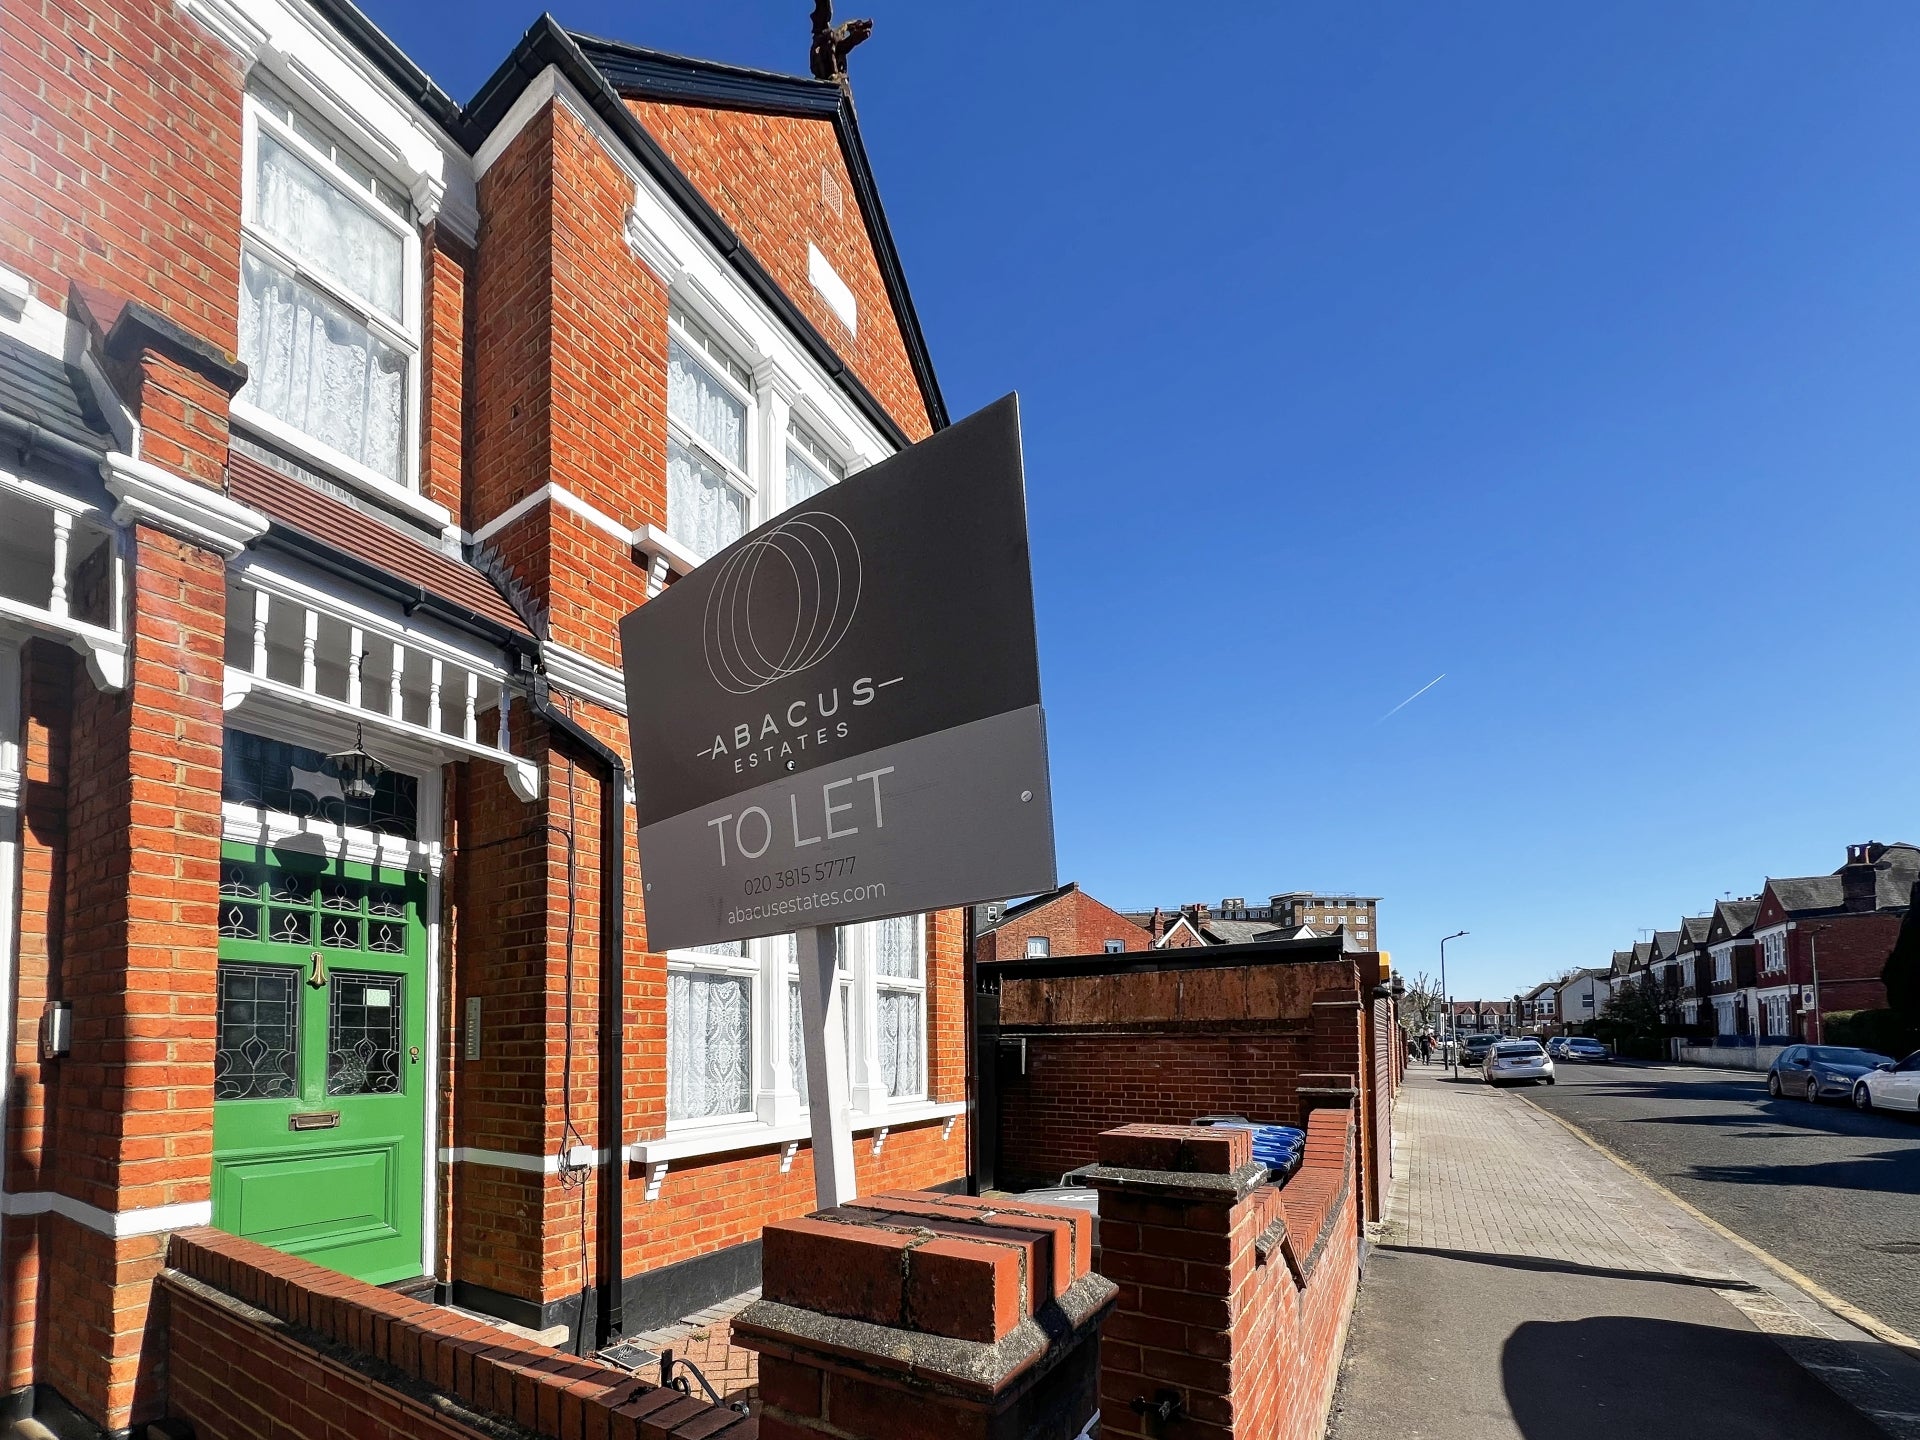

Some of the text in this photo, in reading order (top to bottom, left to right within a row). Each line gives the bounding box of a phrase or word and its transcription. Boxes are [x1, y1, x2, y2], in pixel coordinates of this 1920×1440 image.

[711, 677, 875, 760] ABACUS
[734, 721, 848, 774] ESTATES
[707, 766, 895, 867] TO LET
[744, 856, 856, 896] 020 3815 5777
[728, 882, 886, 924] abacusestates.com
